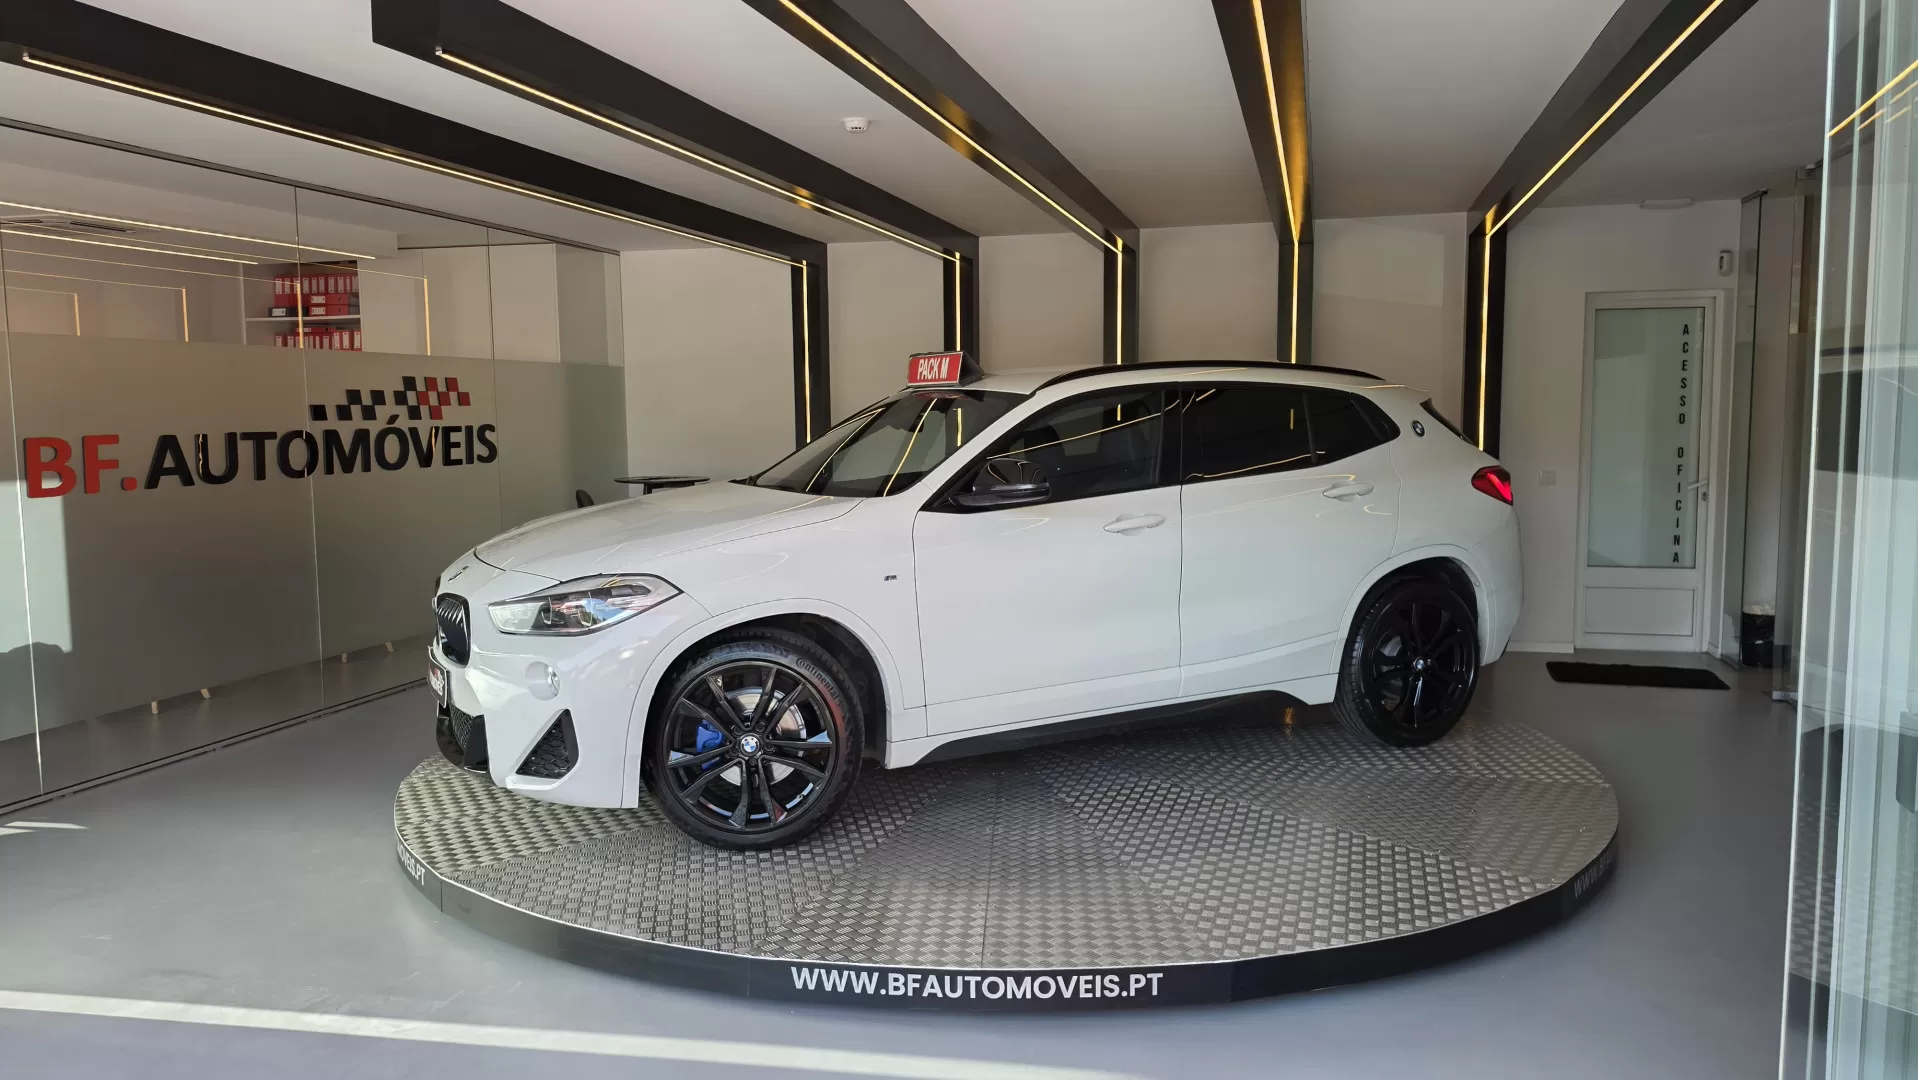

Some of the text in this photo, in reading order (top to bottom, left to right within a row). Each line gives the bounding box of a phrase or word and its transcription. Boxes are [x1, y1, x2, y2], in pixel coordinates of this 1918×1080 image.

[917, 356, 950, 380] PACK M
[1672, 323, 1690, 564] ACESSO OFICINA
[795, 657, 840, 700] Continental
[790, 966, 1164, 1000] WWW.BFAUTOMOVEIS.PT
